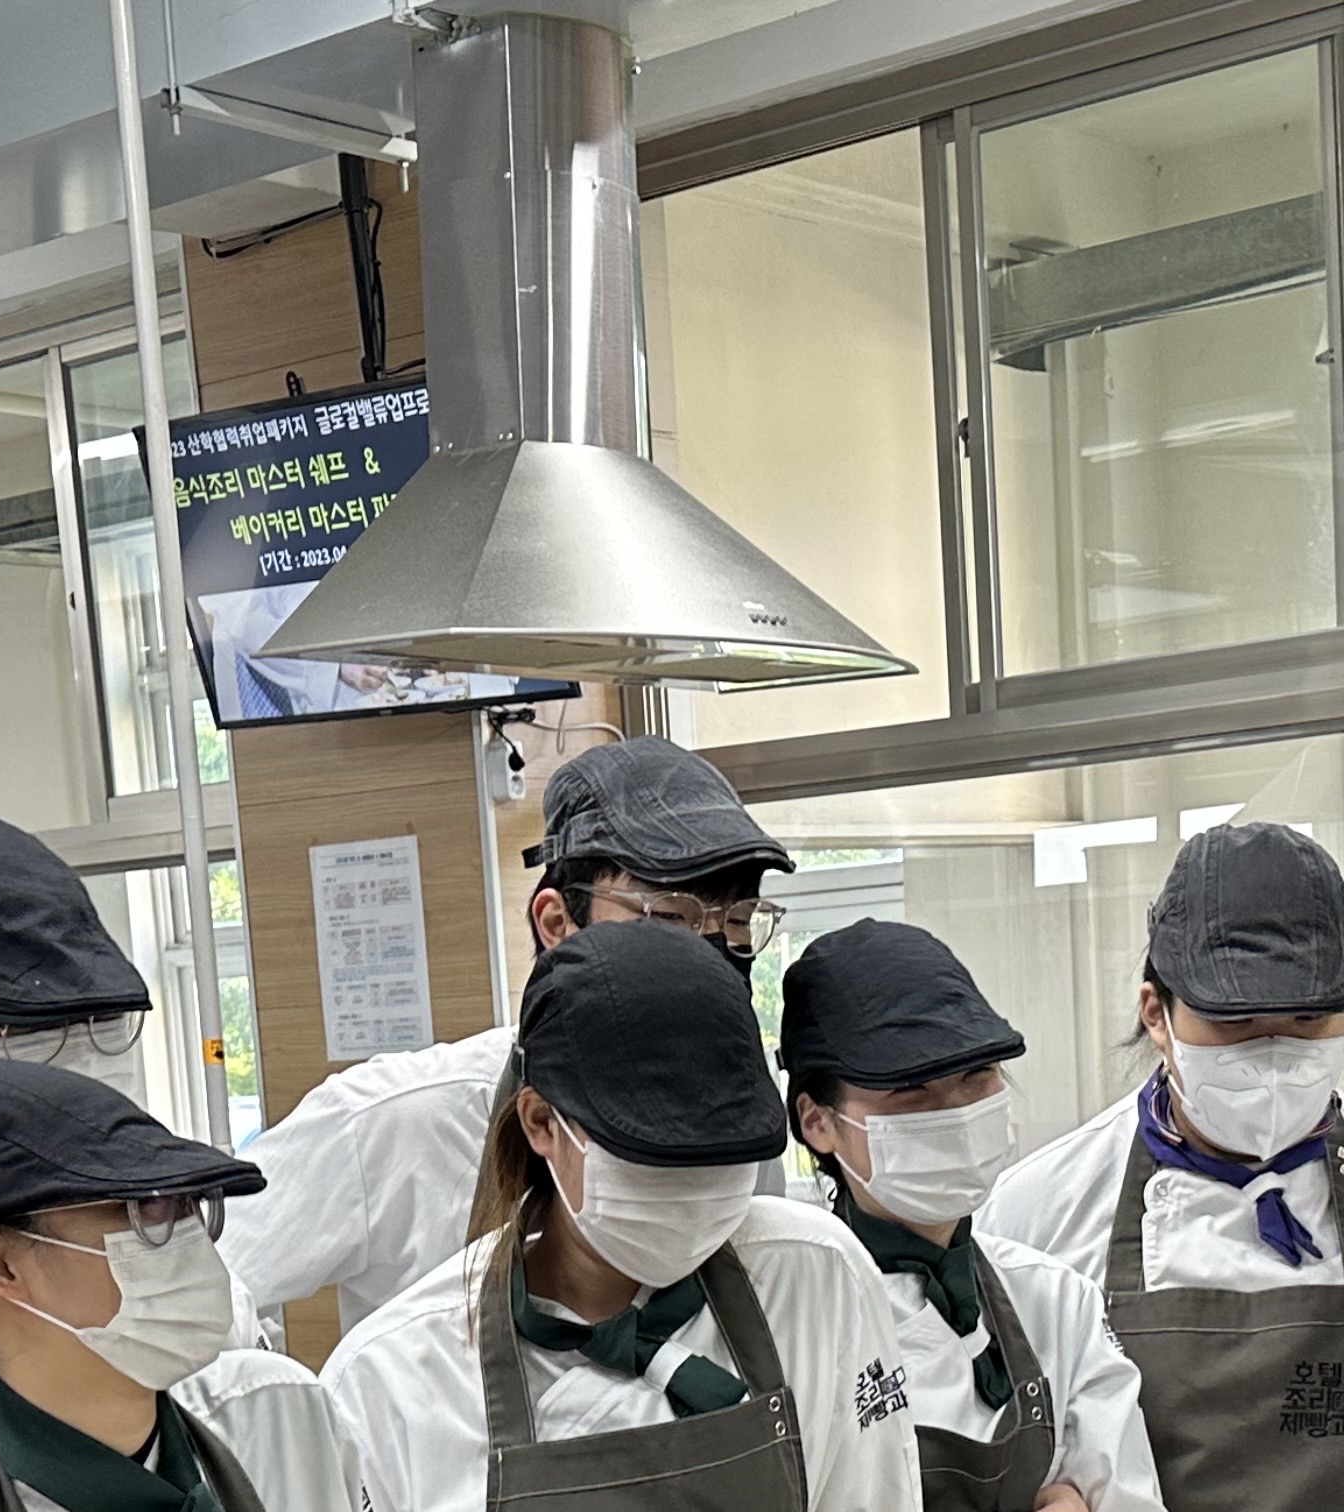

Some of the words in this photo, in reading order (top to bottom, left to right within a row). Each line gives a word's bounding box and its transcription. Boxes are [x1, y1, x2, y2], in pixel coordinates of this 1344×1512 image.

[187, 414, 309, 456] 산학협력취업패키지
[174, 469, 245, 509] 음식조리
[246, 457, 306, 495] 마스터
[309, 452, 350, 486] 쉐프
[363, 447, 381, 475] &
[230, 507, 307, 545] 베이커리
[308, 497, 369, 534] 마스터
[1290, 1360, 1342, 1388] 호텔
[1281, 1386, 1332, 1412] 조리
